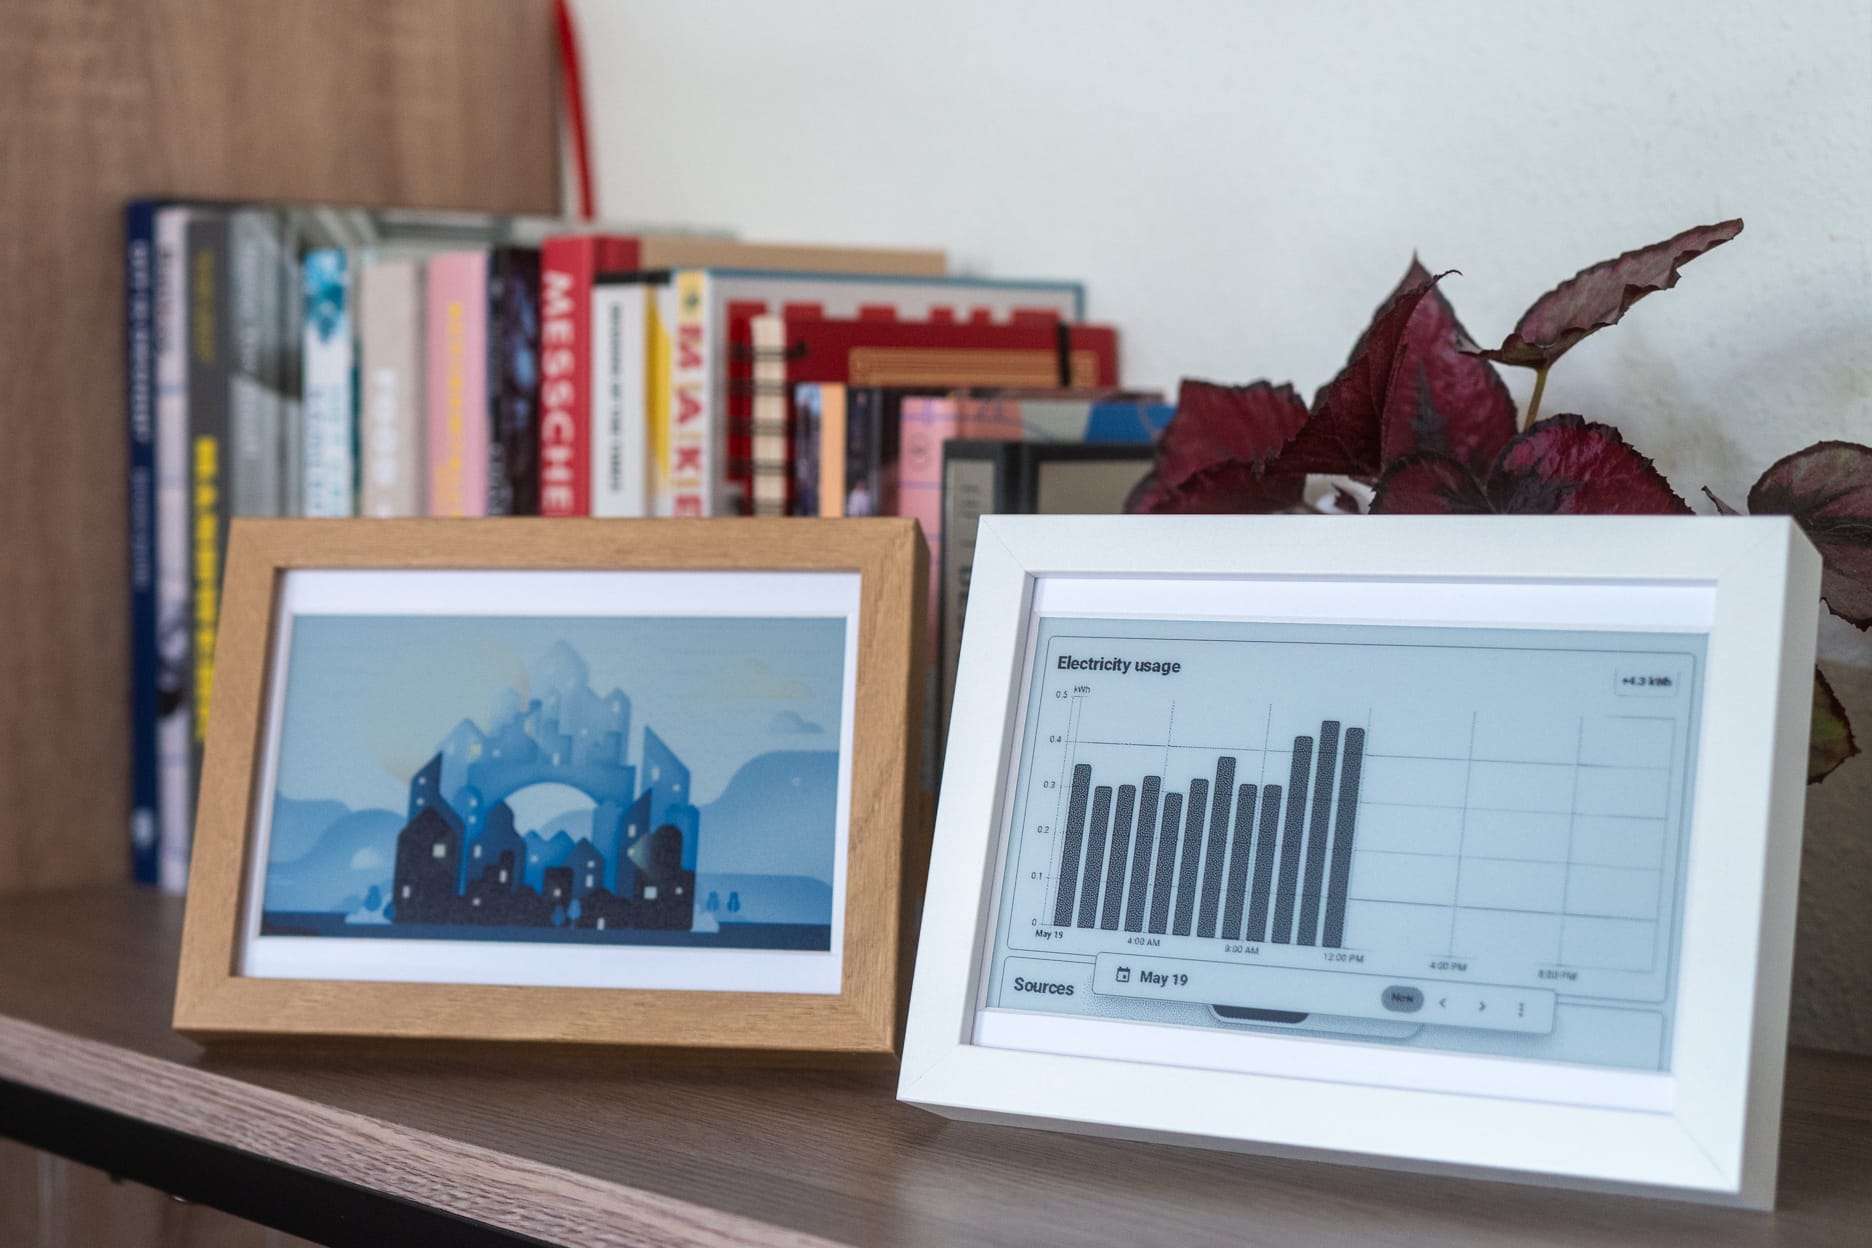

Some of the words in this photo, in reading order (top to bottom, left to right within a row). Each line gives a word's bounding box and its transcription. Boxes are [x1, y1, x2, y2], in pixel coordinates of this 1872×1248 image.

[1057, 655, 1132, 674] Electricity
[1134, 660, 1181, 676] usage
[1055, 690, 1068, 699] 0.5
[1073, 684, 1091, 694] kWh
[1049, 735, 1062, 744] 0.4
[1043, 780, 1056, 789] 0.3
[1037, 825, 1050, 834] 0.2
[1031, 871, 1043, 880] 0.1
[1031, 918, 1037, 927] 0
[1035, 928, 1052, 940] May
[1053, 930, 1064, 940] 19
[1127, 936, 1145, 946] 4:00
[1146, 937, 1161, 947] AM
[1224, 944, 1243, 954] 8:00
[1244, 946, 1259, 955] AM
[1323, 952, 1347, 963] 12:00
[1348, 954, 1364, 964] PM
[1429, 961, 1449, 971] 4:00
[1450, 962, 1468, 972] PM
[1140, 970, 1169, 988] May
[1173, 973, 1189, 987] 19
[1013, 976, 1075, 997] Sources
